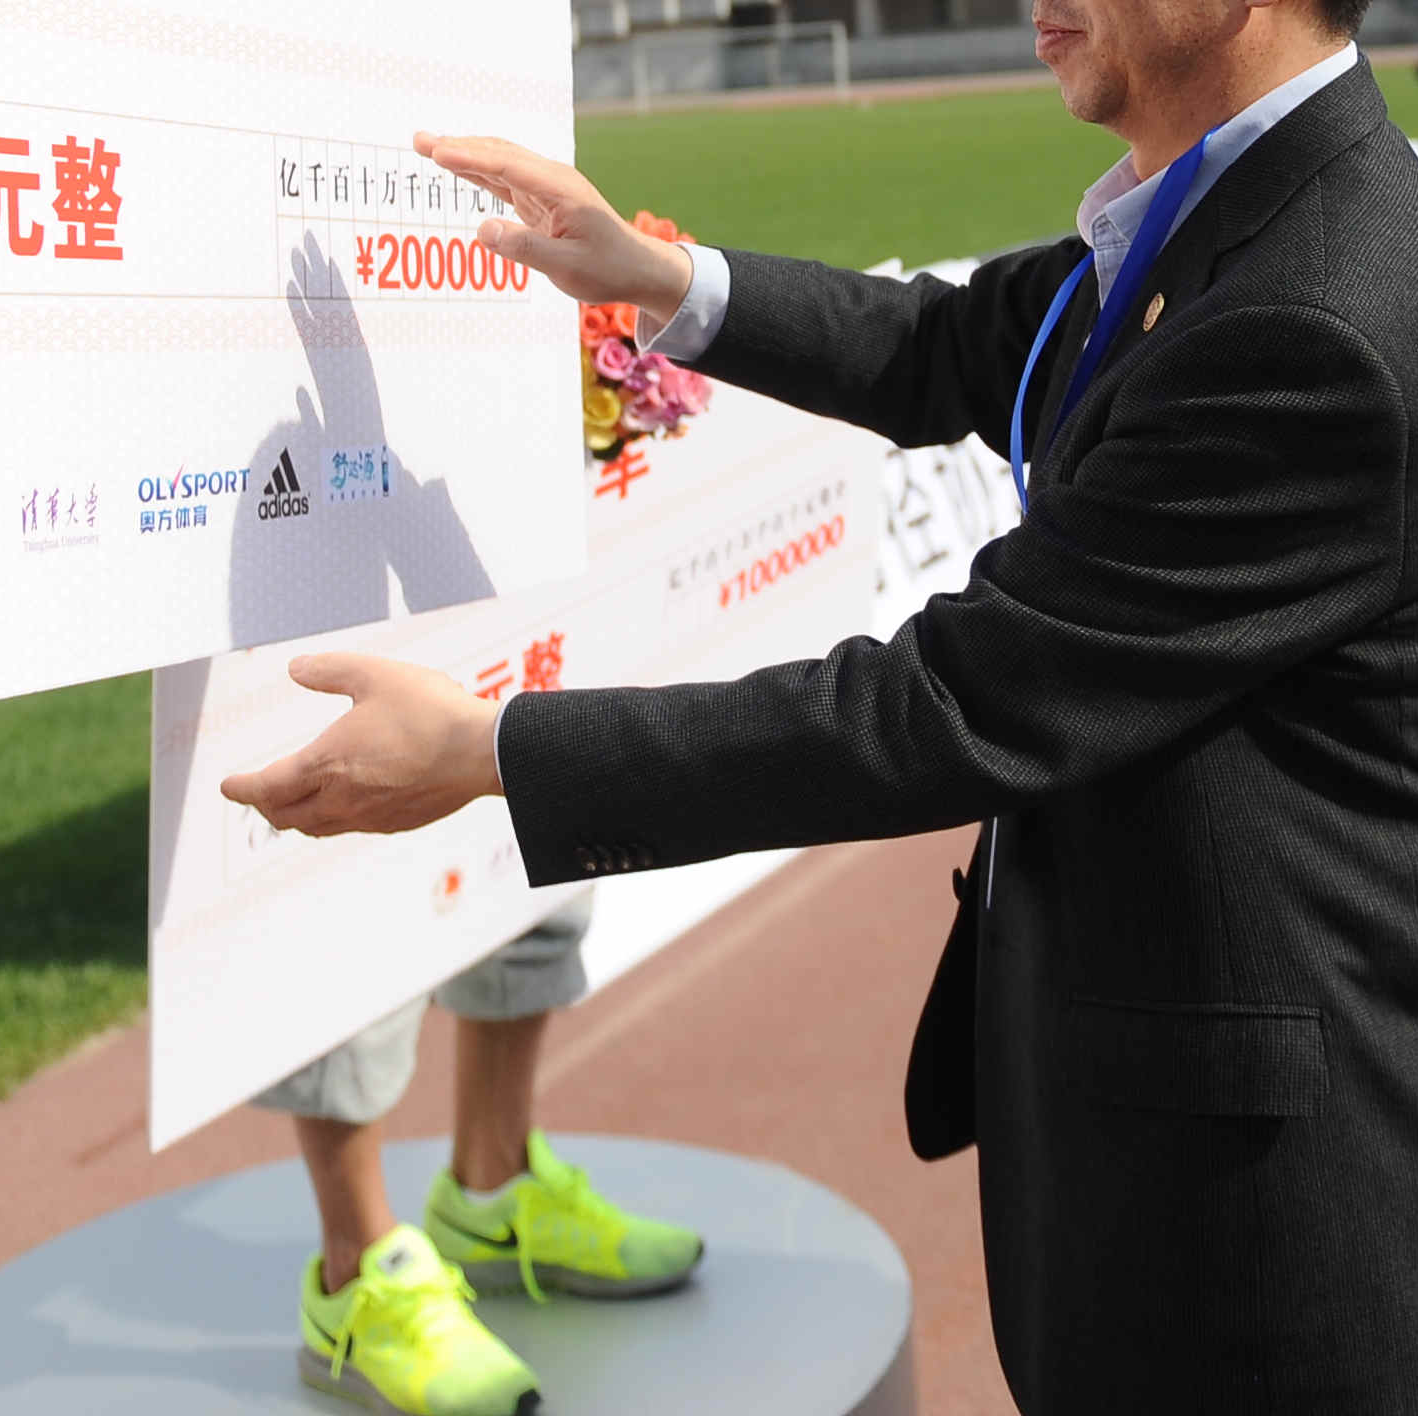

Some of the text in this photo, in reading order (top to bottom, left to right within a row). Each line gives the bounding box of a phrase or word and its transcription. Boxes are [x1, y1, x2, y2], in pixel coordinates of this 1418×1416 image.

[138, 464, 251, 503] OLYSPORT
[140, 505, 208, 534] 奥方体育
[258, 494, 310, 521] adidas
